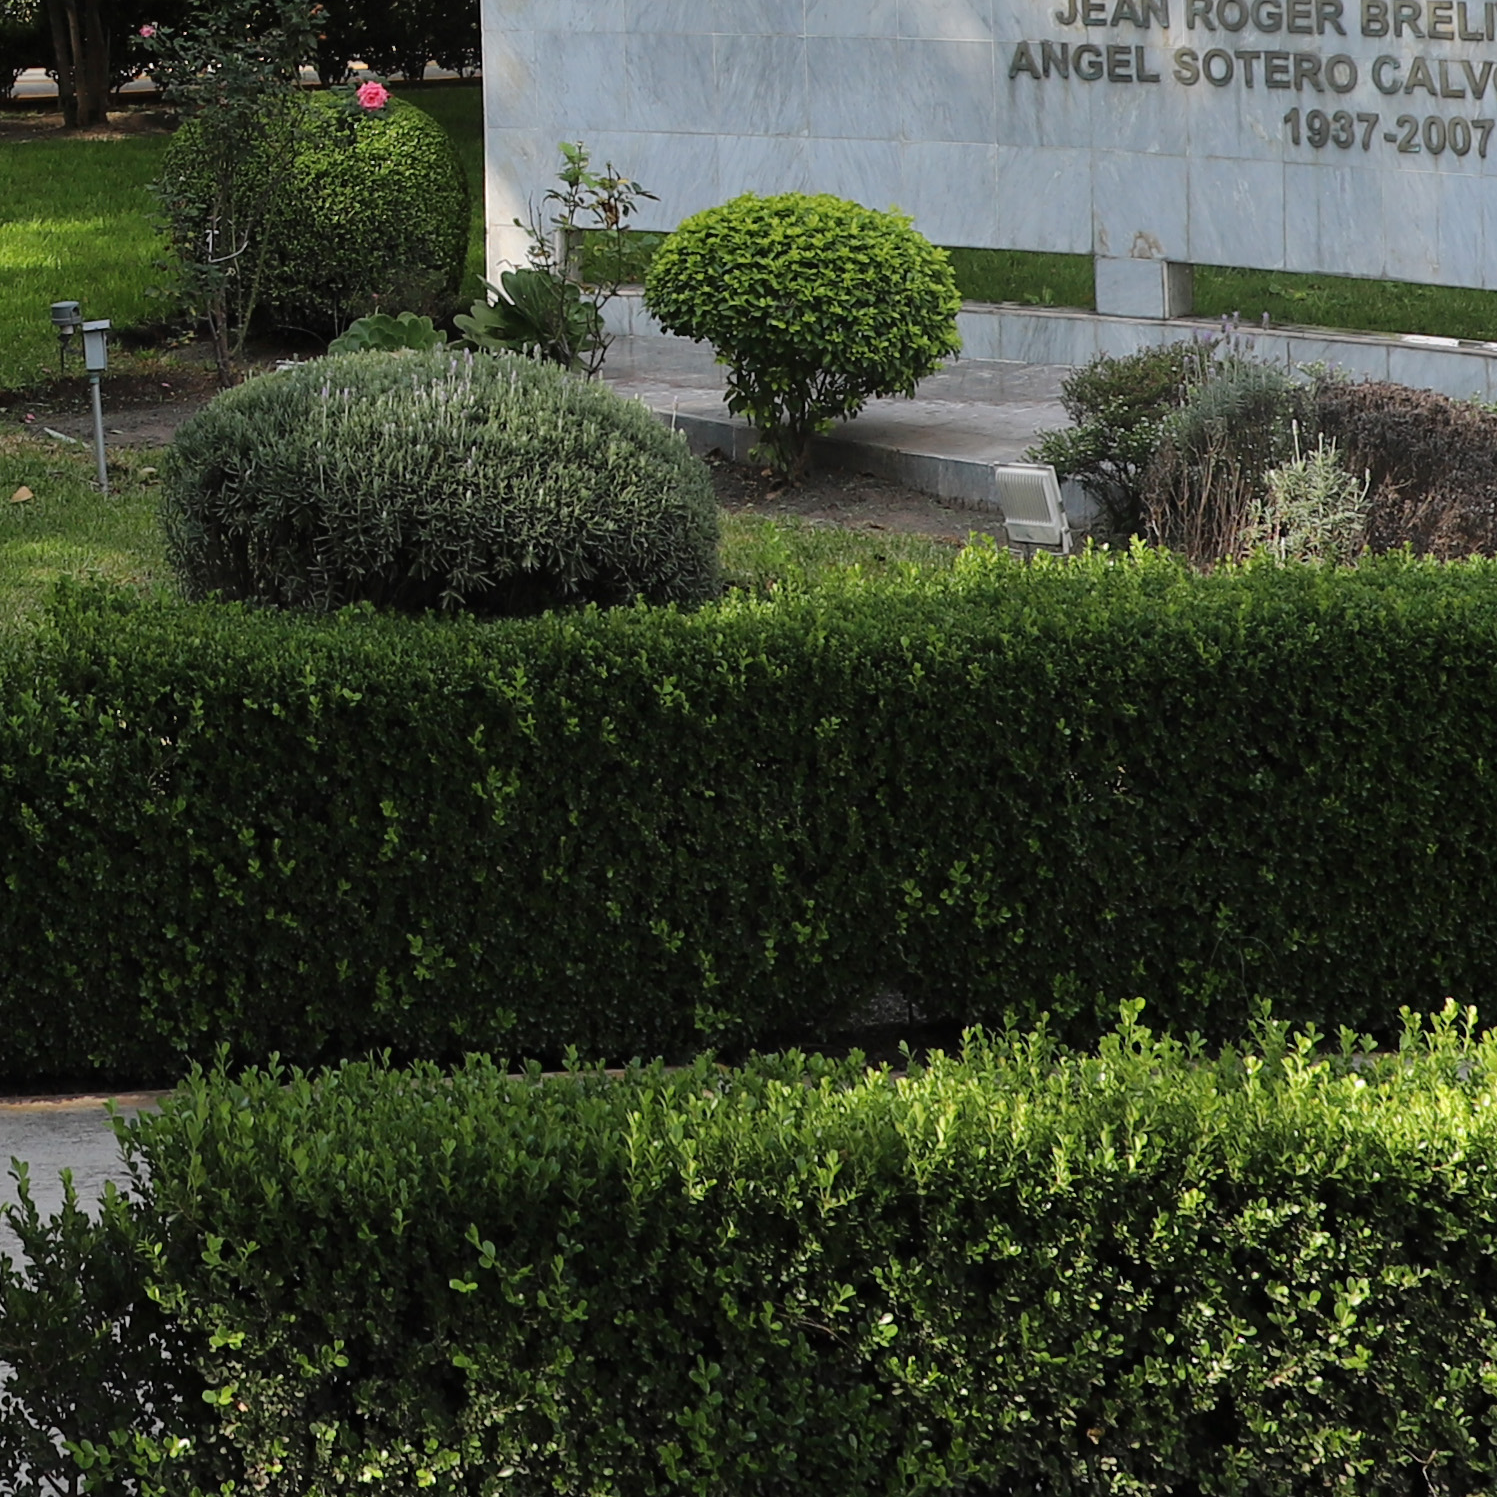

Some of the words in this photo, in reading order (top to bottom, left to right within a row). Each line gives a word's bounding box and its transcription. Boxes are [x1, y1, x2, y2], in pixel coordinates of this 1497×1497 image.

[1008, 40, 1162, 83] ANGEL
[1174, 47, 1359, 95] SOTERO
[1284, 107, 1496, 159] 1937-2007
